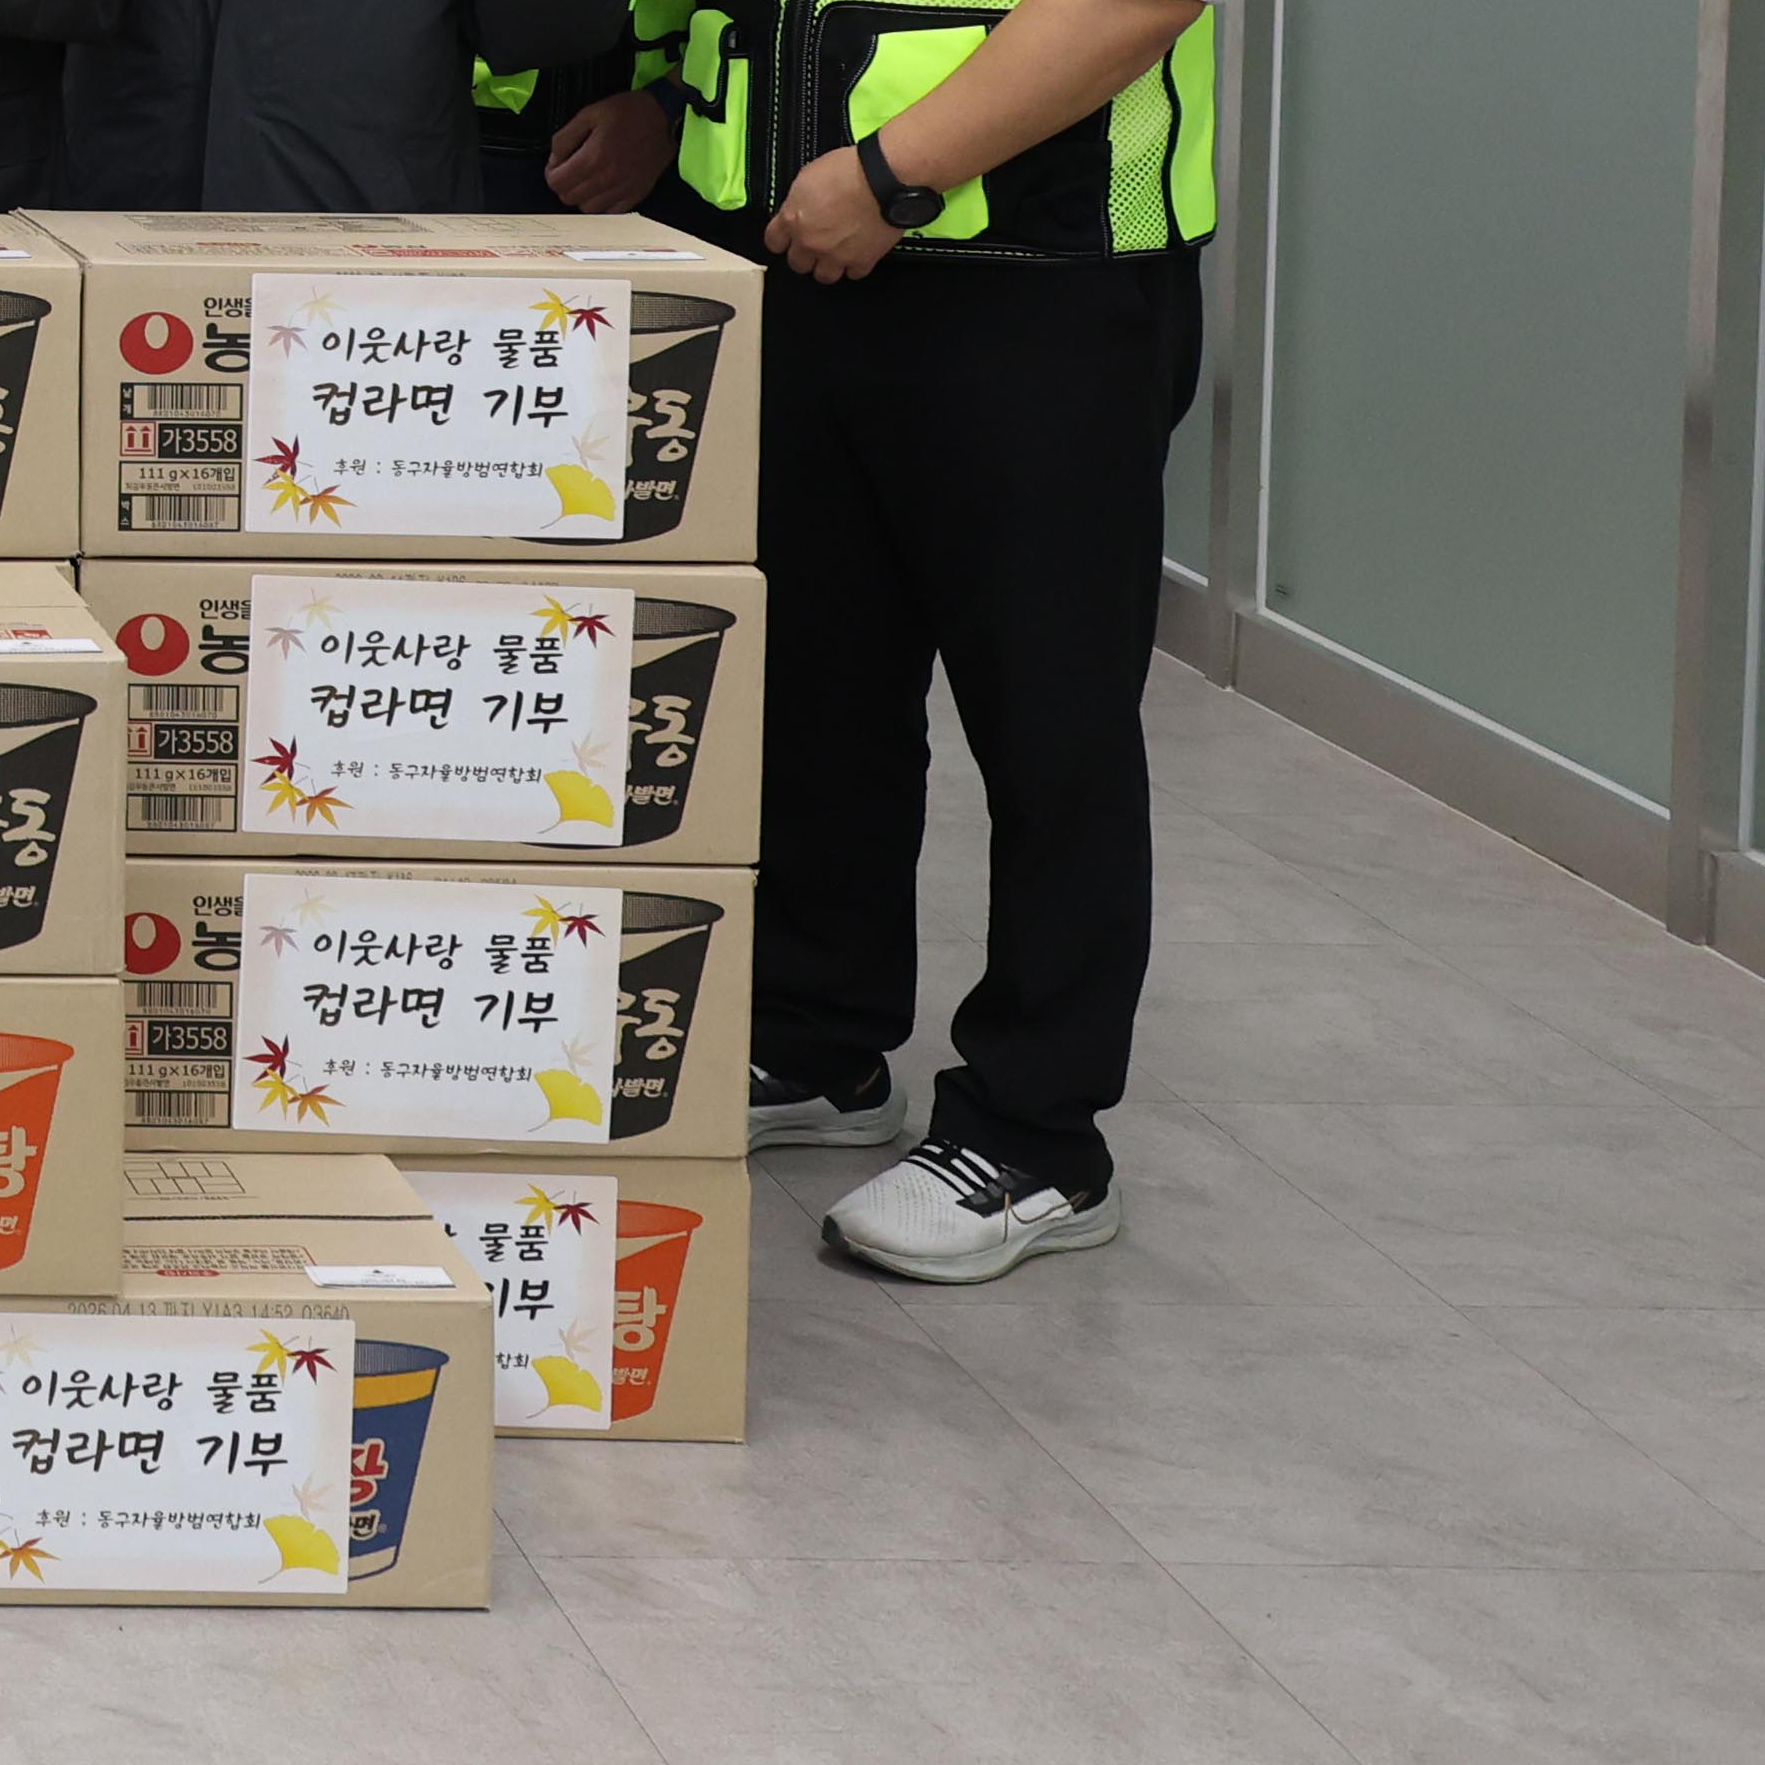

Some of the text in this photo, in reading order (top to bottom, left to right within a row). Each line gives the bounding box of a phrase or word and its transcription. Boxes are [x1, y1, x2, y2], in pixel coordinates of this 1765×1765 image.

[322, 327, 563, 369] 이웃사랑 물품
[312, 381, 569, 428] 컵라면 기부
[163, 428, 237, 454] 가3558
[320, 630, 564, 675] 이웃사랑 물품
[310, 684, 569, 734] 컵라면 기부
[313, 929, 554, 975] 이웃사랑 물품
[303, 983, 559, 1034] 컵라면 기부
[479, 1222, 549, 1263] 물품
[22, 1369, 282, 1414] 이웃사랑 물품
[12, 1428, 288, 1477] 컵라면 기부
[35, 1509, 261, 1531] 후원 동구자율방범연합회
